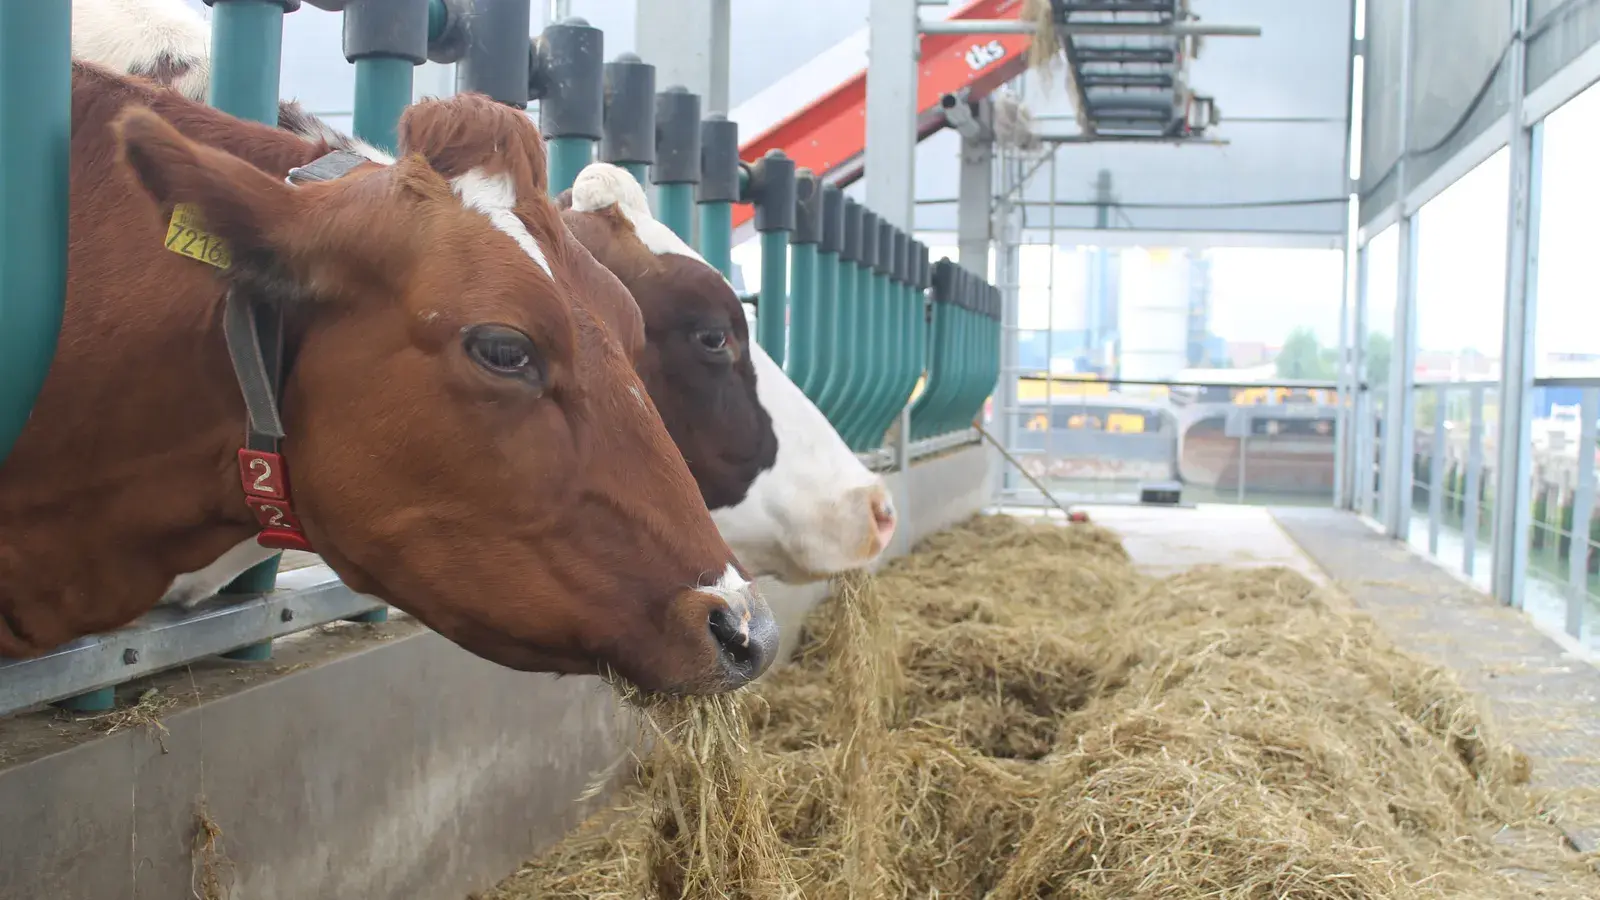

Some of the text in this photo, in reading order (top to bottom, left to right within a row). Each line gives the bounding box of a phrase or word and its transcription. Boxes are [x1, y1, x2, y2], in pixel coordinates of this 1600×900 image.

[965, 40, 1005, 71] tks
[166, 222, 222, 262] 7216
[249, 458, 274, 493] 2
[260, 504, 291, 528] 2
